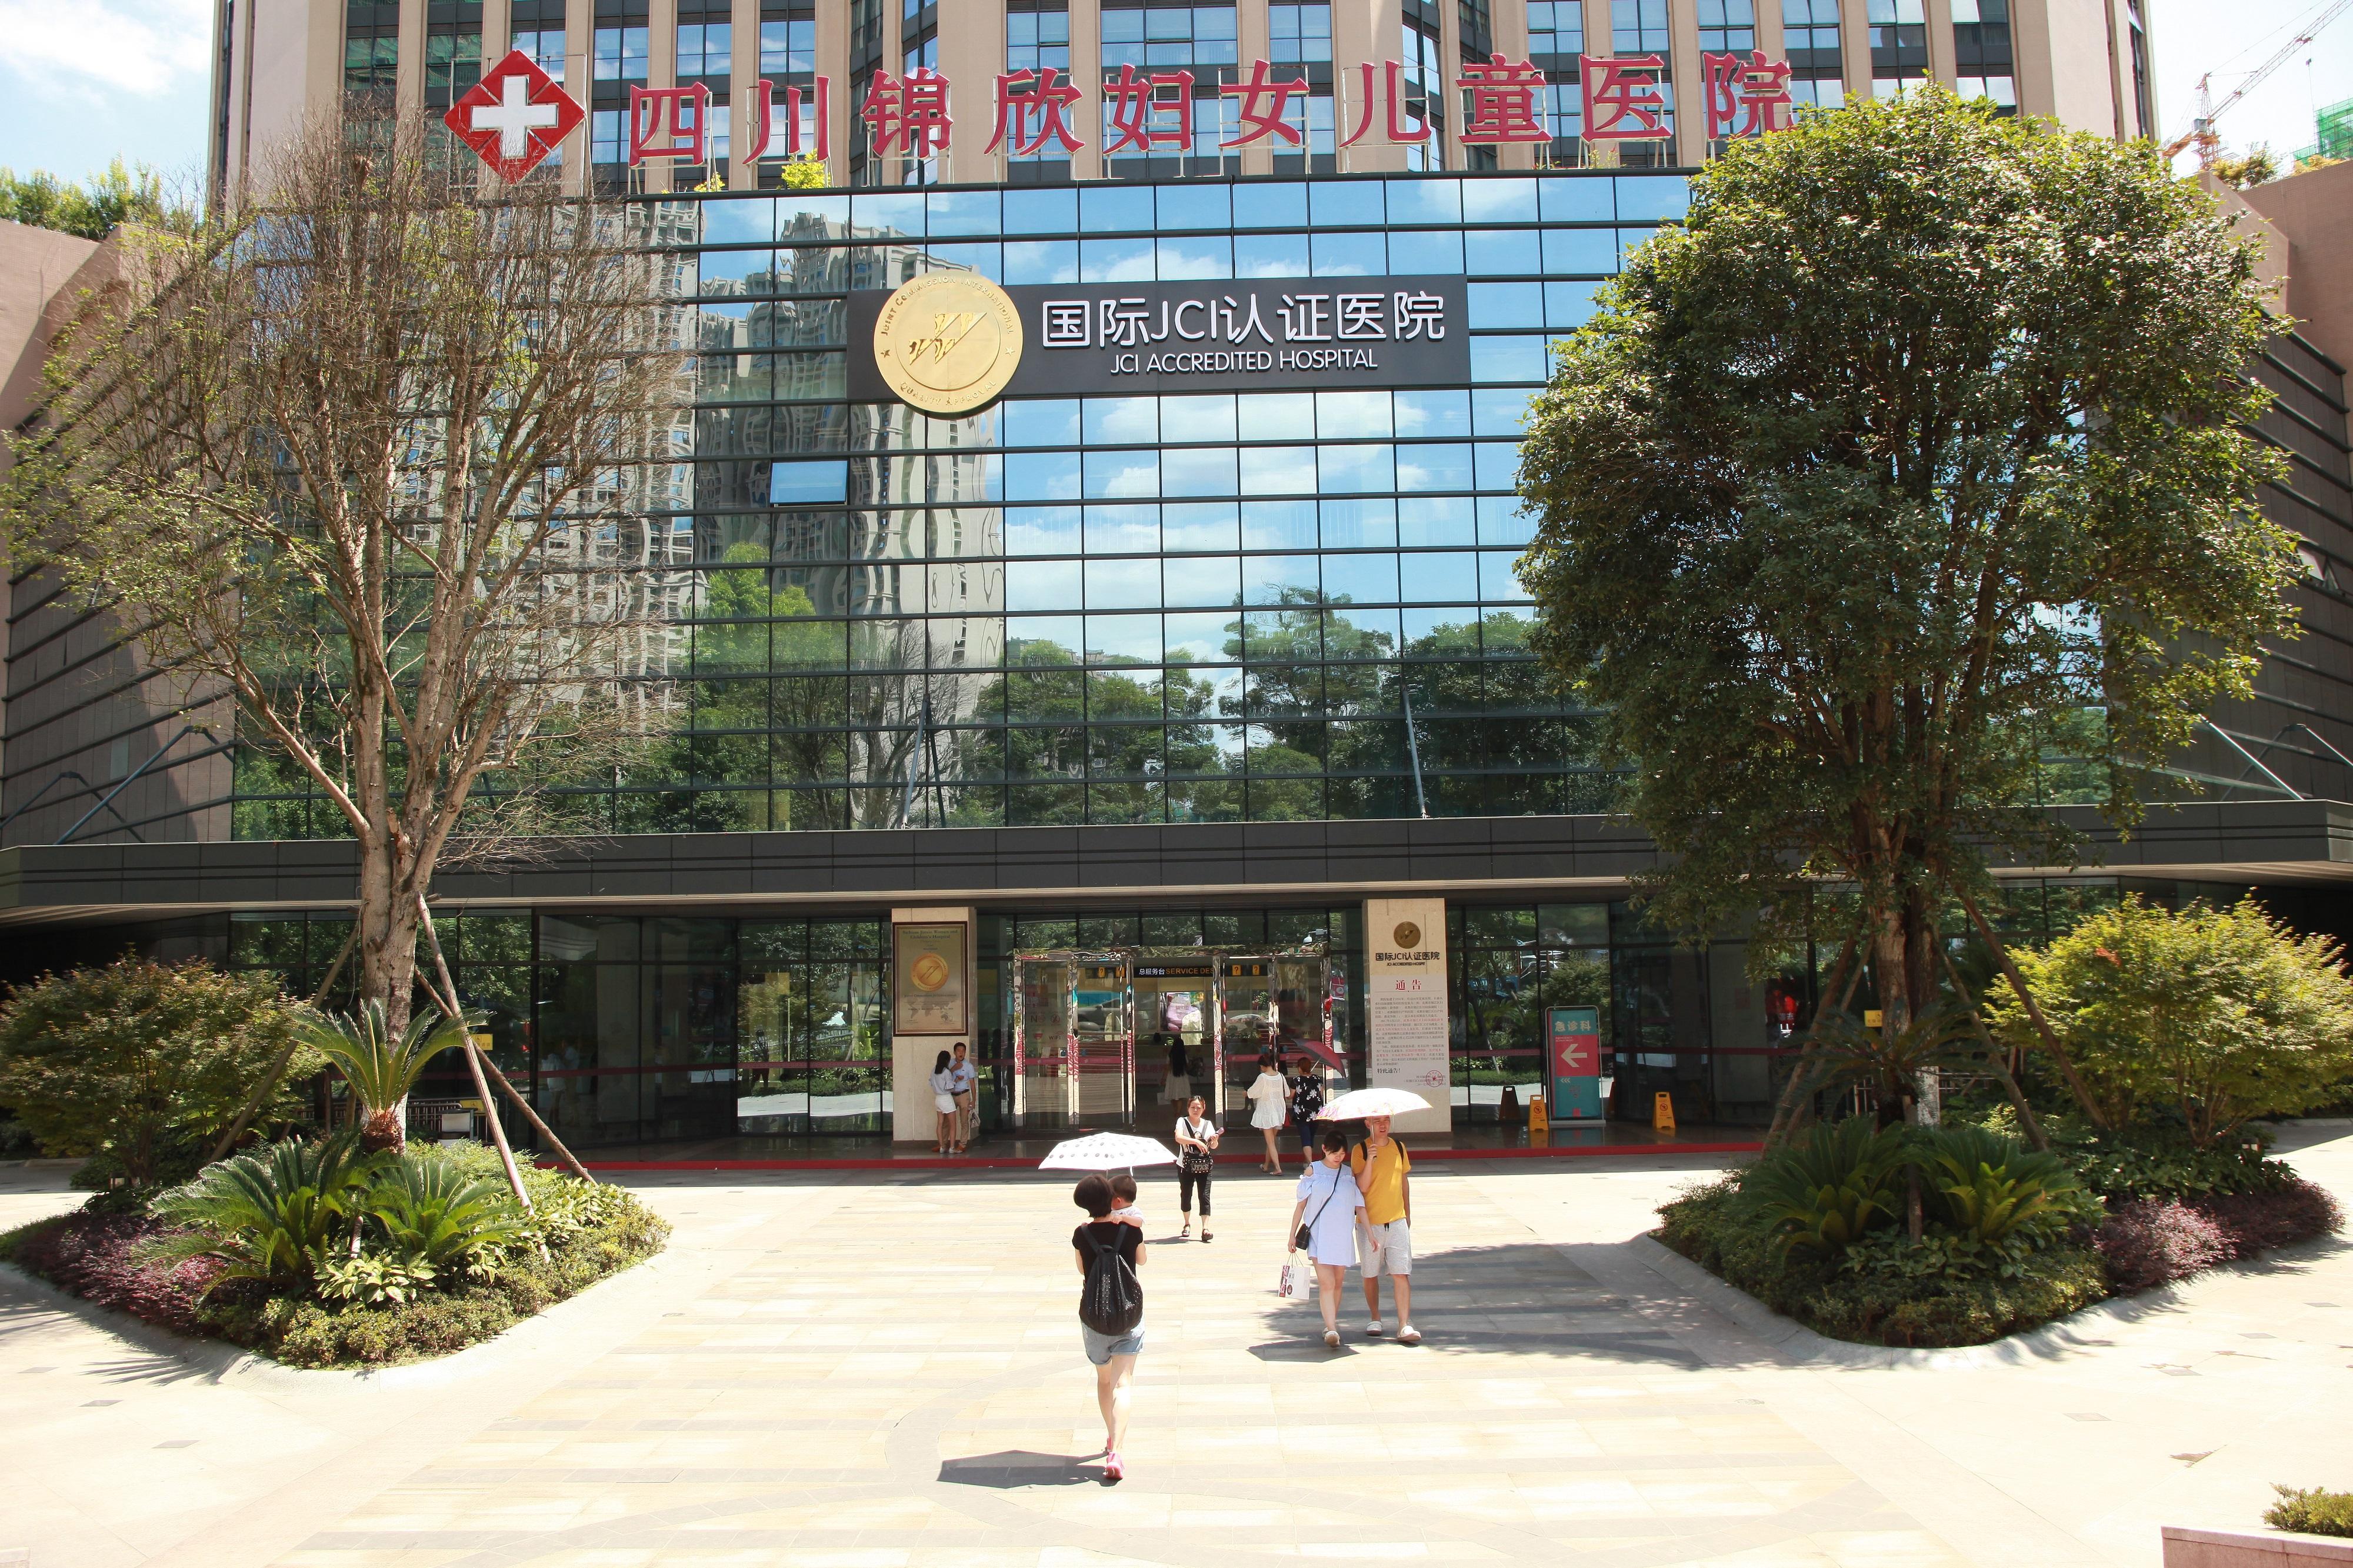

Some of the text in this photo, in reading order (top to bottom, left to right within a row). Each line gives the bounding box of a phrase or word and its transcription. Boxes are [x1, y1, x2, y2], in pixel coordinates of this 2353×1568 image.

[629, 51, 1798, 168] 四川锦欣妇女儿童医院
[961, 277, 1015, 335] INTERNATIONAL
[1042, 291, 1445, 351] 国际JCI认证医院
[1110, 348, 1378, 375] JCI ACCREDITED HOSPITAL
[899, 380, 997, 406] QUALITY APPROVAL
[1375, 951, 1440, 961] 国际JCI认证医院
[1395, 979, 1421, 990] 通告
[1555, 1020, 1591, 1032] 急诊科
